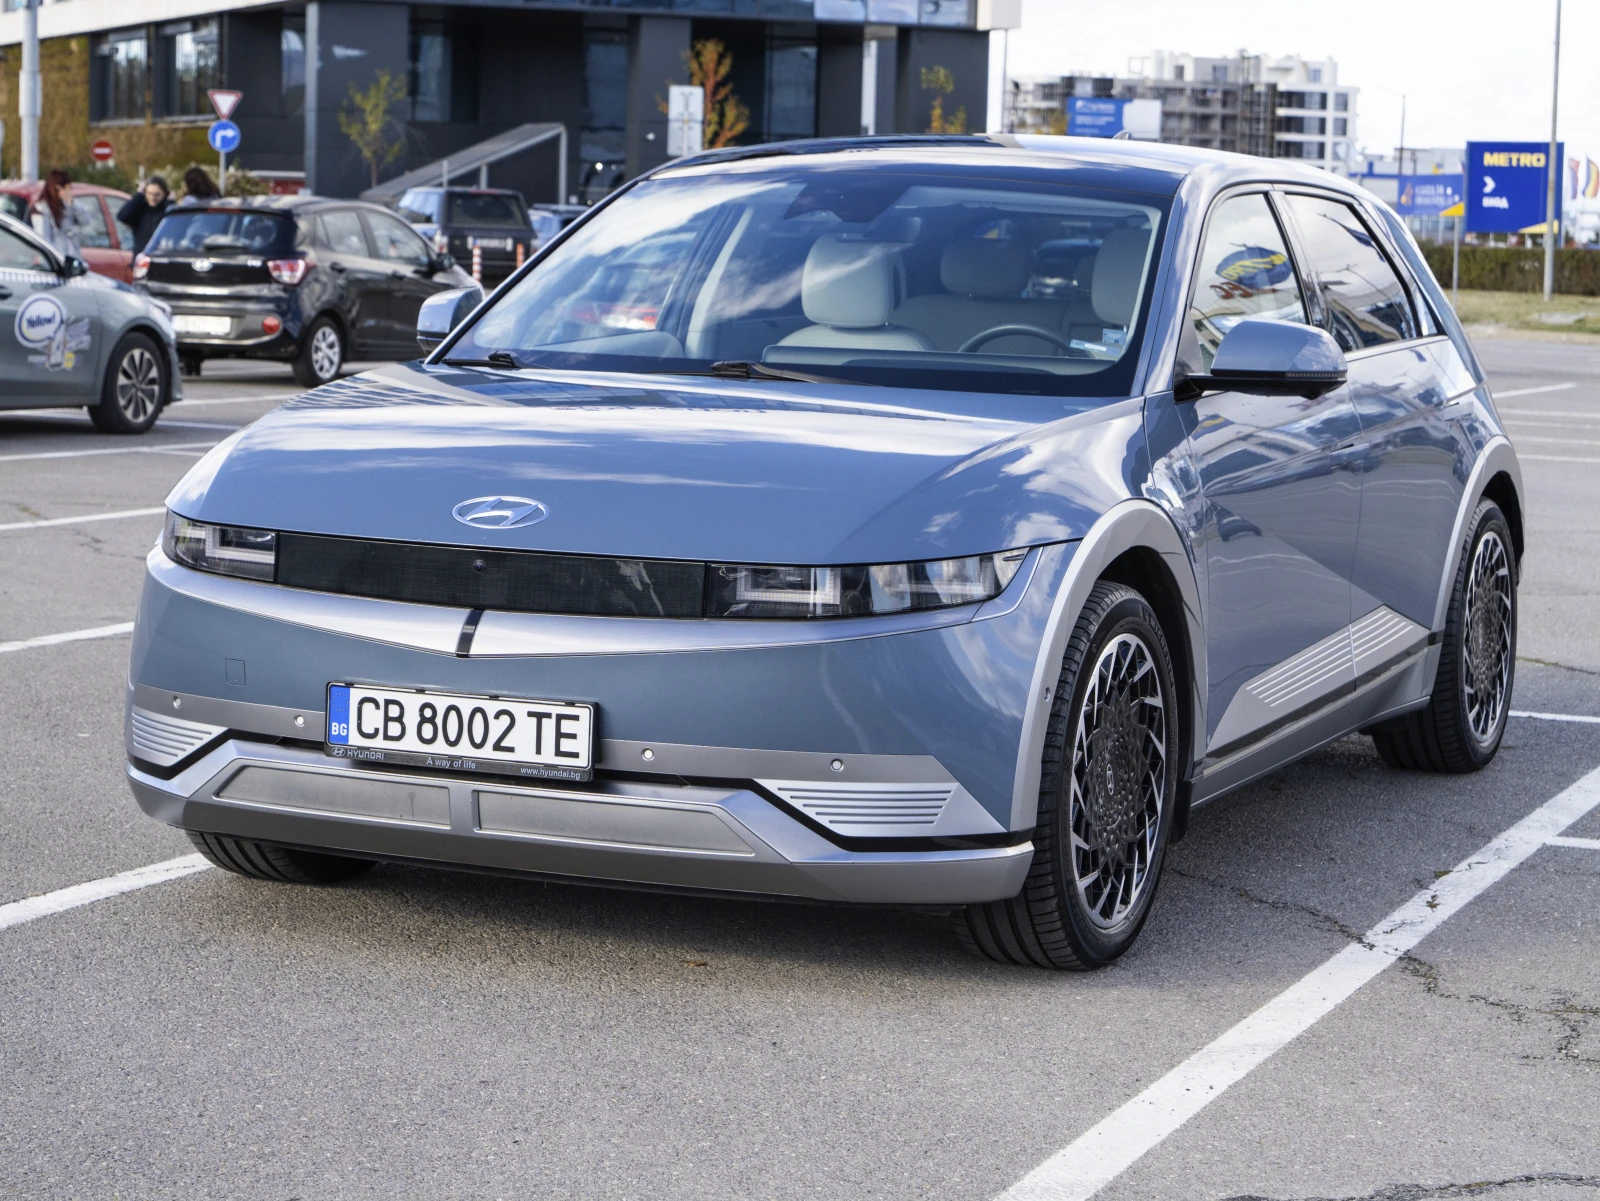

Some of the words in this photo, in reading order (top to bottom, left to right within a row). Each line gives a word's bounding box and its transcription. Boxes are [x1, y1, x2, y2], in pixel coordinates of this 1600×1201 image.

[1483, 151, 1546, 167] METRO
[331, 722, 348, 736] BG
[357, 696, 406, 742] CB
[416, 701, 517, 753] 8002
[526, 710, 580, 759] TE
[347, 749, 385, 760] HYUNDAI
[426, 756, 433, 766] A
[435, 759, 451, 769] way
[453, 760, 462, 769] of
[463, 760, 476, 770] life
[520, 767, 581, 781] www.hyundai.bg
